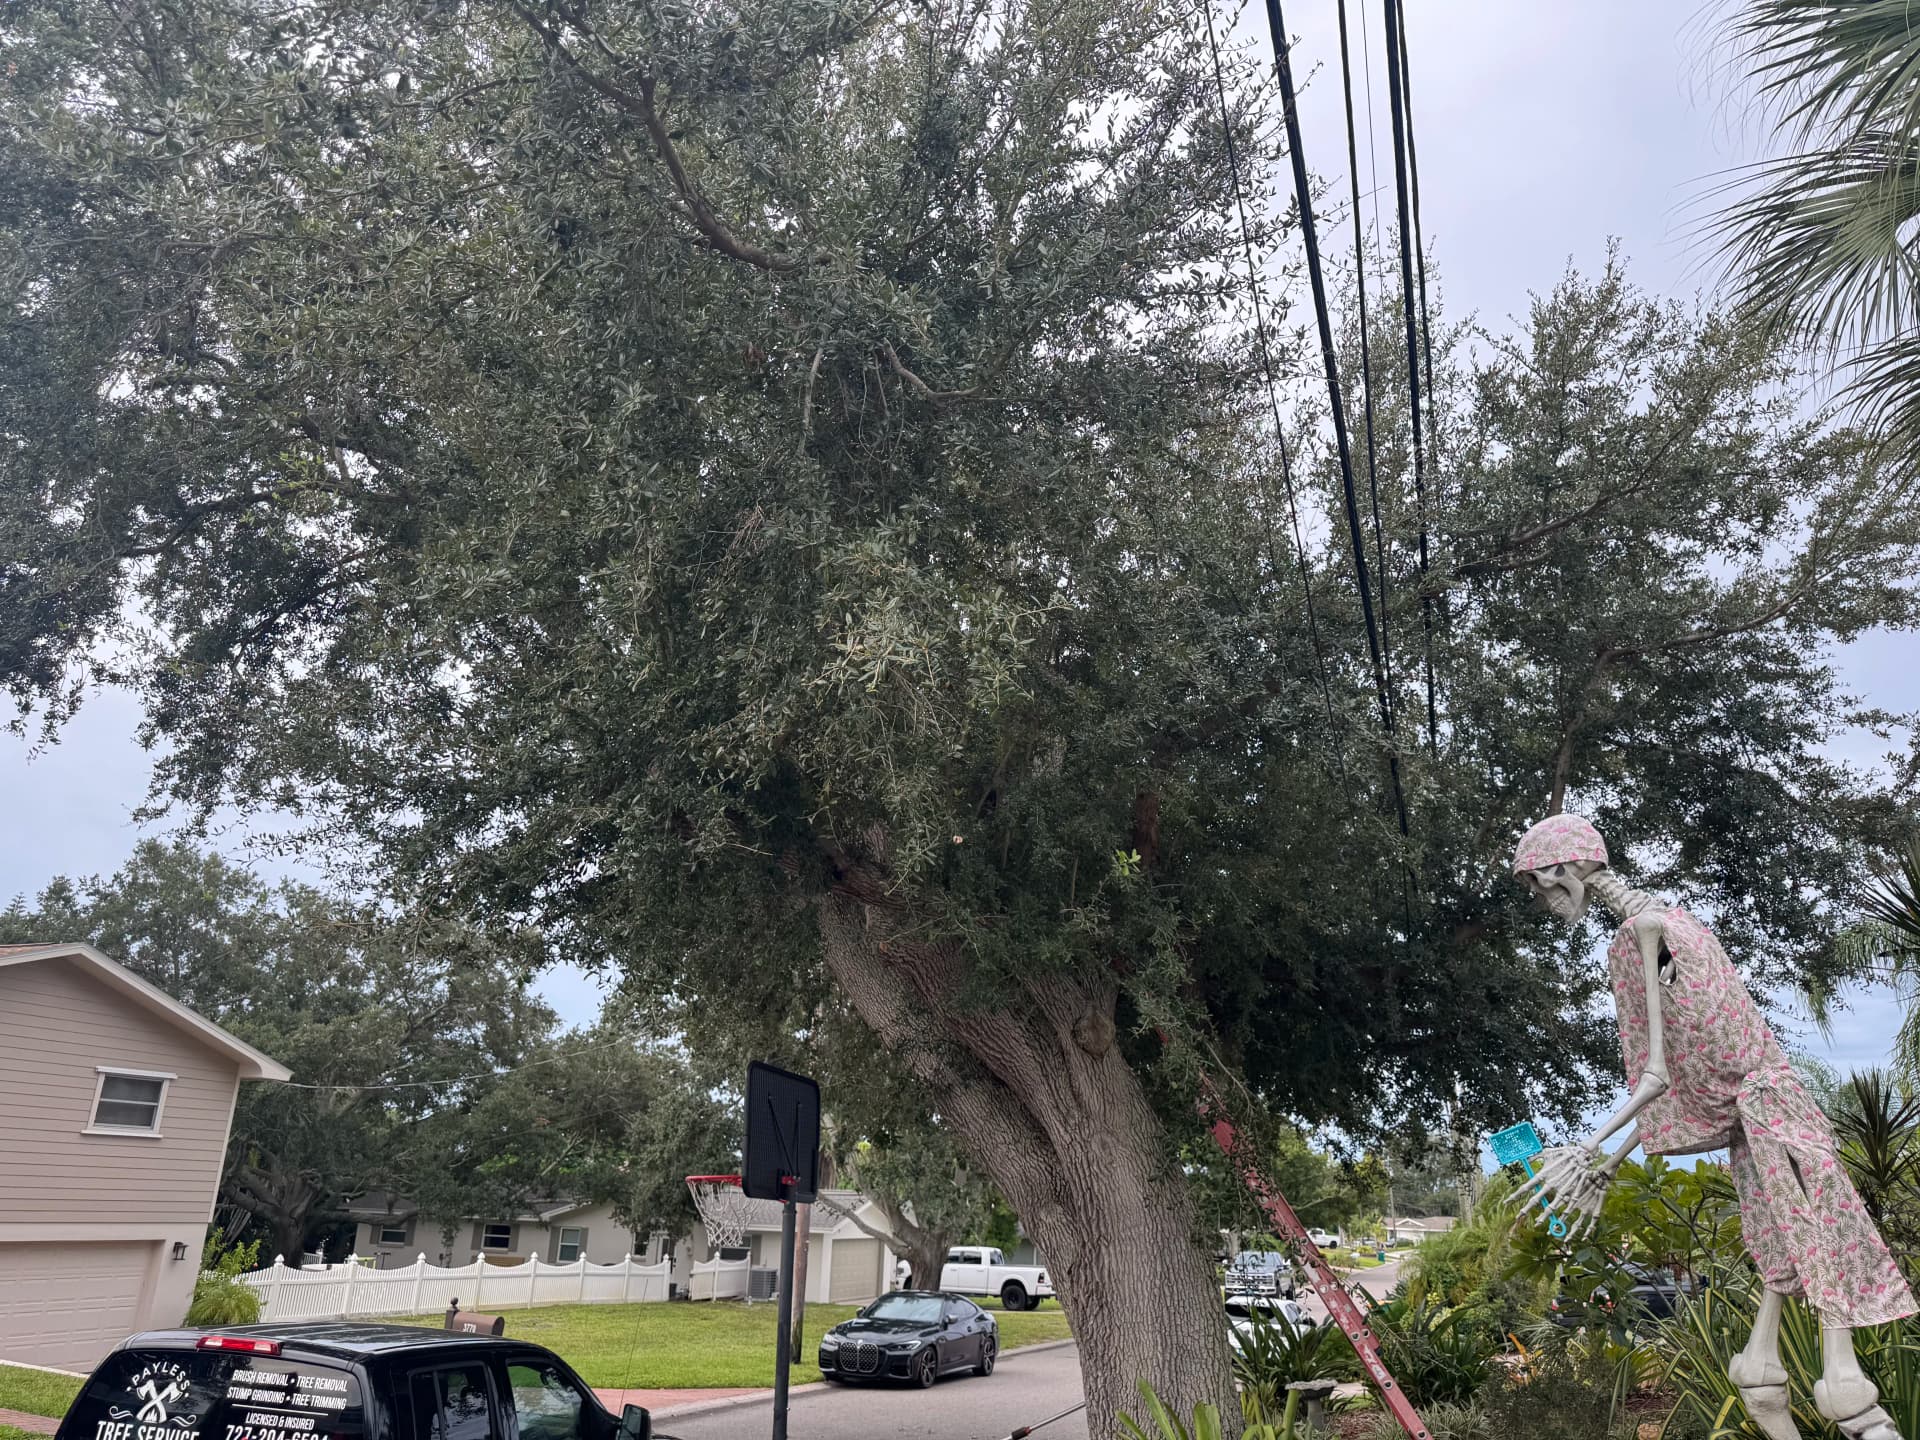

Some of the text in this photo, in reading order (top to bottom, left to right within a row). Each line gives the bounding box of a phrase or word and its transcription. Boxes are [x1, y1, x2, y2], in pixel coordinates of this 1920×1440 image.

[131, 1361, 190, 1391] PAYLESS
[232, 1369, 348, 1392] BRUSH REMOVAL TREE REMOVAL
[227, 1386, 347, 1410] STUMP GRINDING TREE TRIMMING
[95, 1420, 134, 1440] TREE
[245, 1412, 315, 1430] LICENSED & INSURED
[225, 1424, 329, 1440] 727-204-
